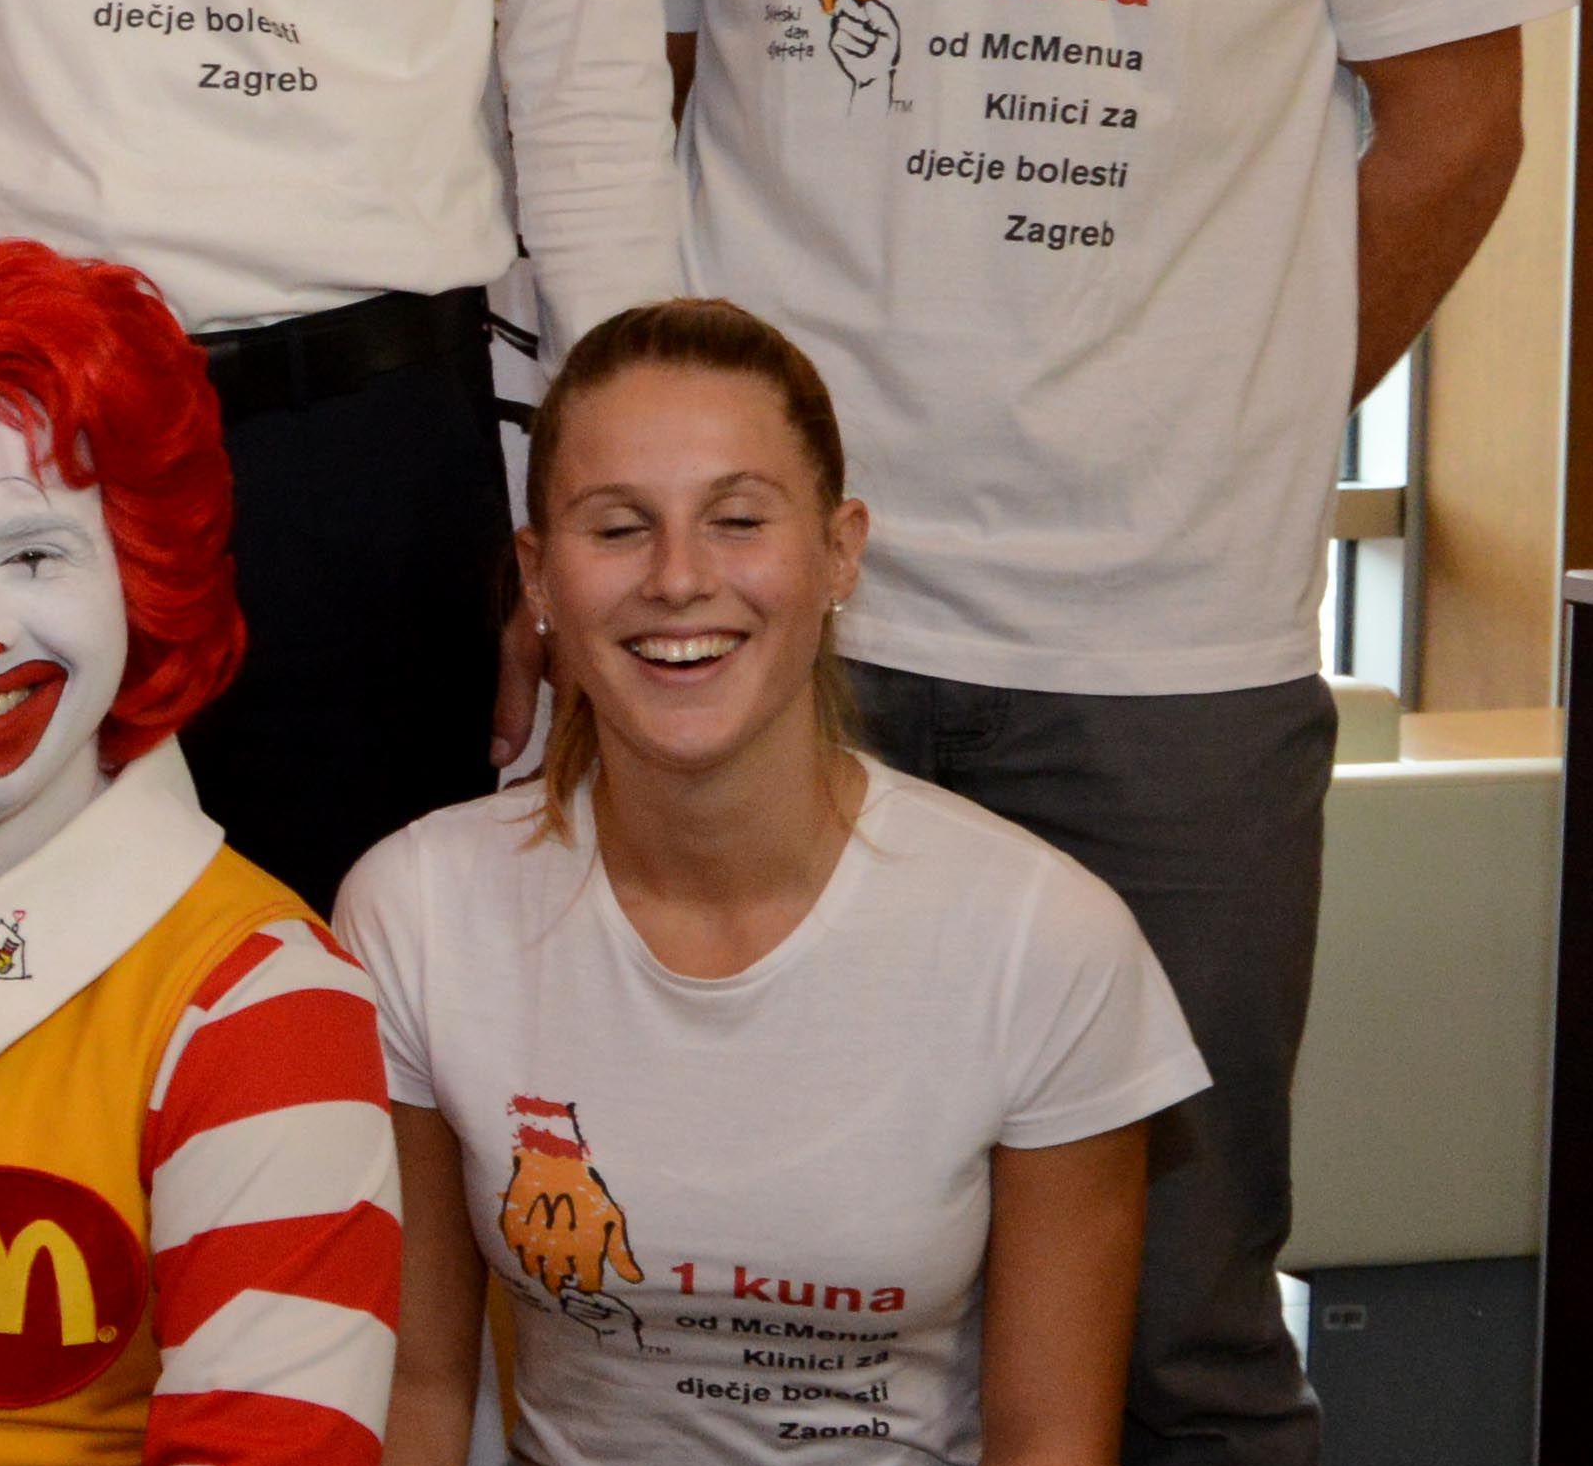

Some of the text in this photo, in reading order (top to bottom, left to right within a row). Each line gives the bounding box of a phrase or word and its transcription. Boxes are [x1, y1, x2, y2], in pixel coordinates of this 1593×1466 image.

[94, 3, 195, 35] dječje
[928, 32, 1143, 72] od McMenua
[198, 63, 317, 97] Zagreb
[984, 93, 1139, 129] Klinici za
[907, 150, 1128, 188] dječje bolesti
[1004, 215, 1115, 251] Zagreb
[671, 1262, 906, 1313] 1 kuna
[675, 1315, 718, 1330] od
[743, 1349, 889, 1371] Klinici za
[675, 1377, 771, 1405] dječje
